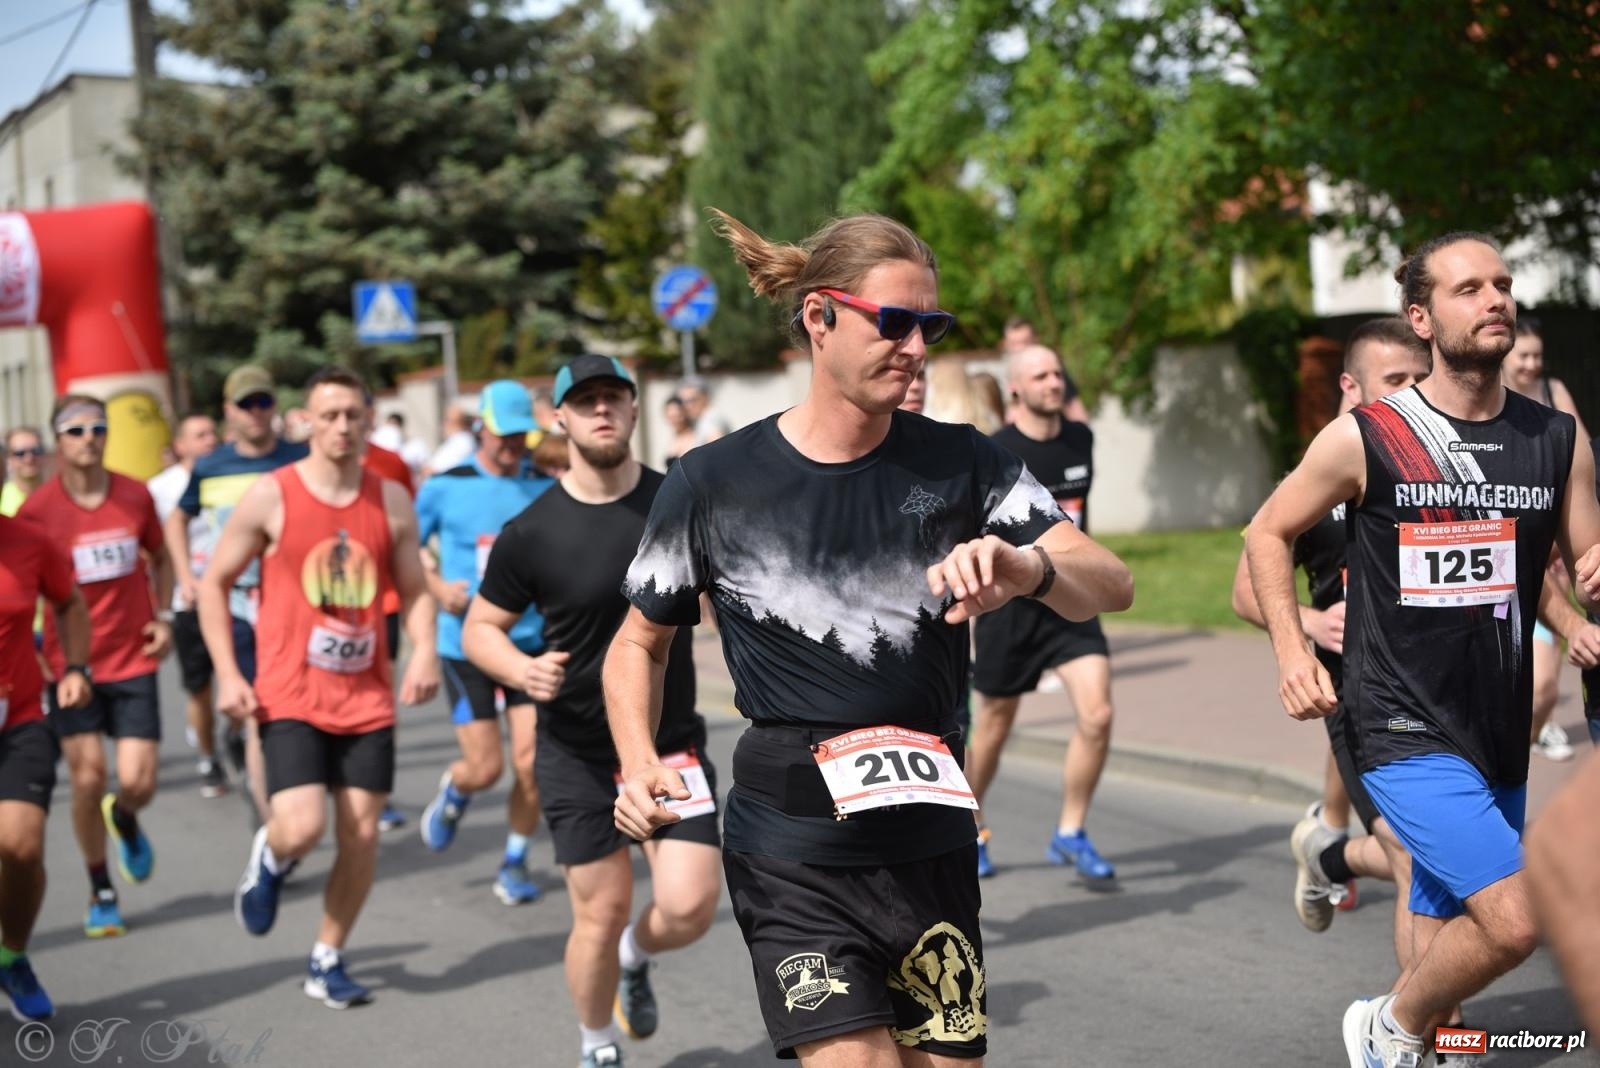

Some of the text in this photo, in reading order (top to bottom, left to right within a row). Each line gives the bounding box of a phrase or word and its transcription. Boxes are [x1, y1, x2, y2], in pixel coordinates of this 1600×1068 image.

[1395, 483, 1555, 511] RUNMAGEDDON
[1413, 522, 1502, 535] XVI BIEG BEZ GRANIC
[1425, 548, 1493, 584] 125
[830, 737, 849, 749] XVI
[875, 727, 897, 737] BEZ
[854, 750, 940, 786] 210
[779, 958, 822, 979] BIEGAM
